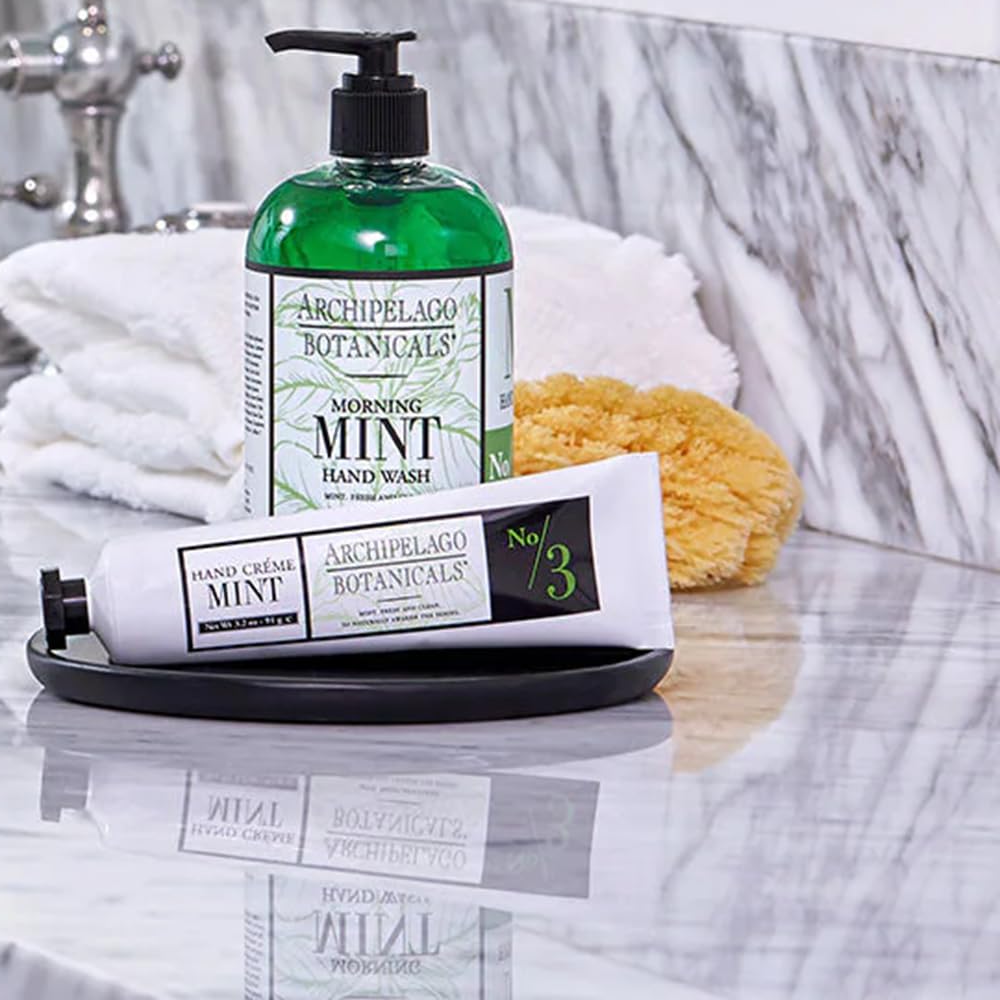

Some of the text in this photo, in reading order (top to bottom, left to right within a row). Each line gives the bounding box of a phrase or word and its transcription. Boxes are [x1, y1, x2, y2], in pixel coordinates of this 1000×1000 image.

[297, 293, 458, 323] ARCHIPELAGO
[331, 398, 423, 414] MORNING
[313, 415, 443, 461] MINT
[322, 468, 431, 485] HAND WASH
[324, 530, 467, 566] ARCHIPELAGO
[191, 565, 237, 581] HAND
[207, 576, 283, 610] MINT
